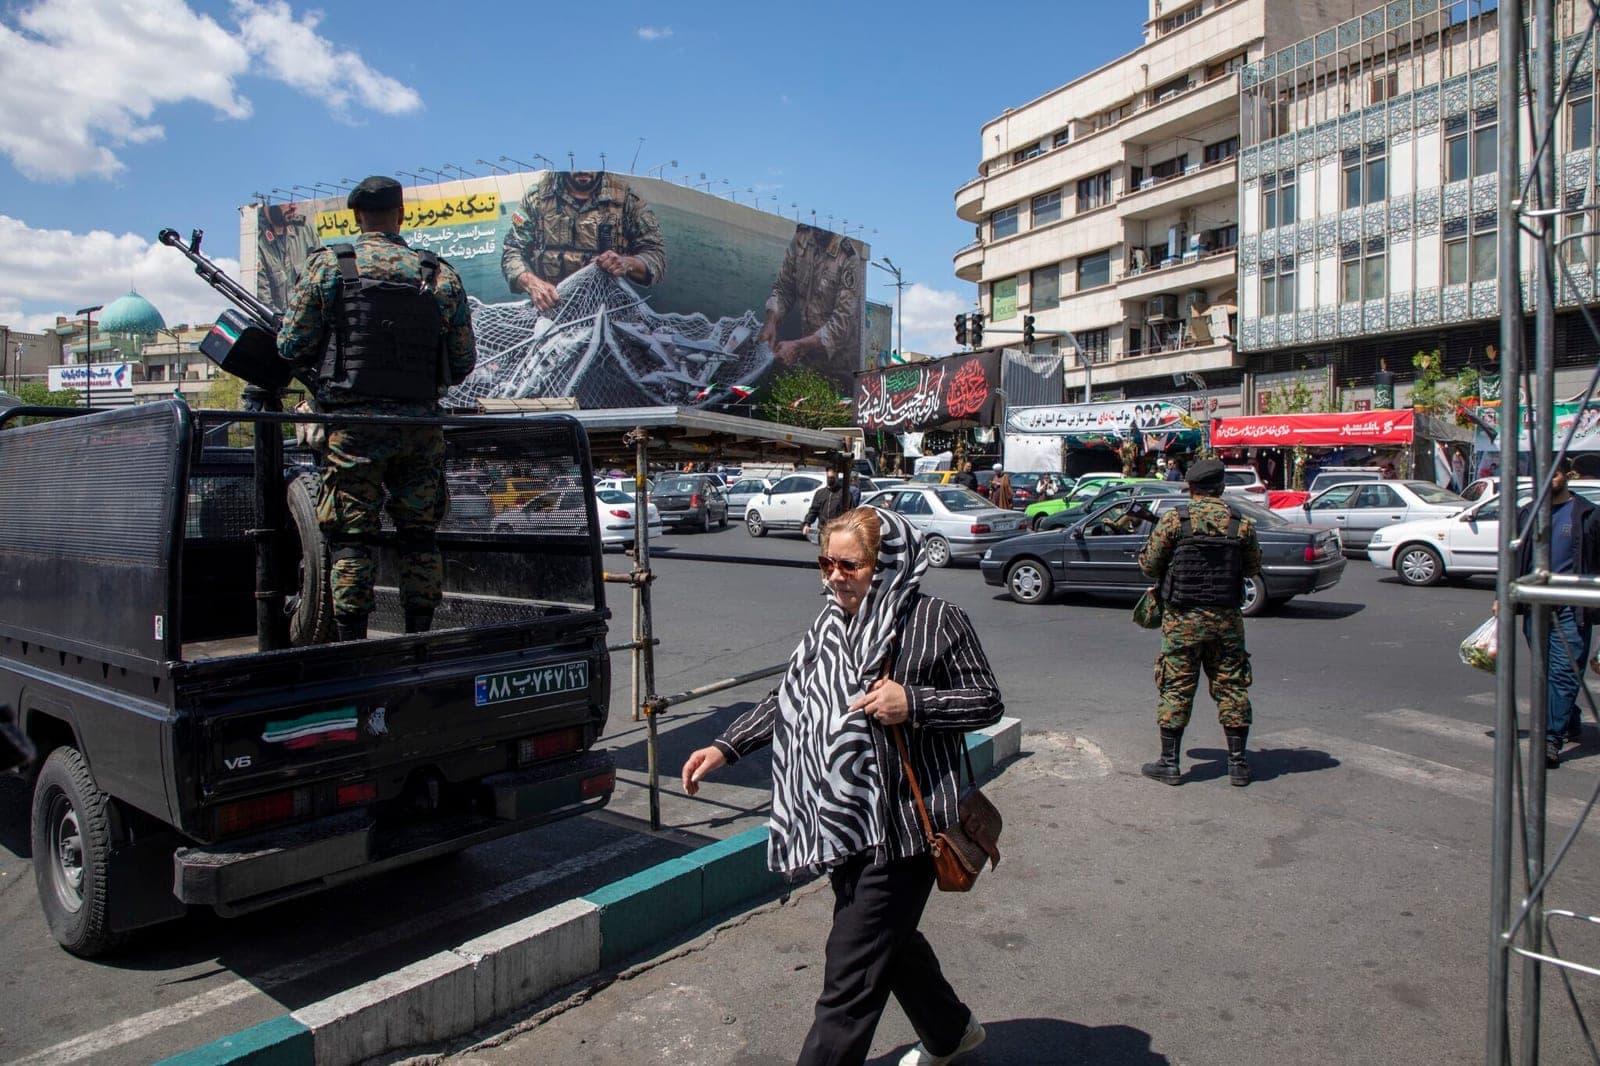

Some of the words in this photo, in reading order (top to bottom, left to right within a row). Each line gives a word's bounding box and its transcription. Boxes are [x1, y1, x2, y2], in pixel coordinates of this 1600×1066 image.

[413, 203, 454, 227] هرمز
[422, 227, 455, 247] خلیج
[453, 225, 496, 243] سراسر
[463, 240, 496, 260] قلمرو
[224, 755, 252, 770] V6
